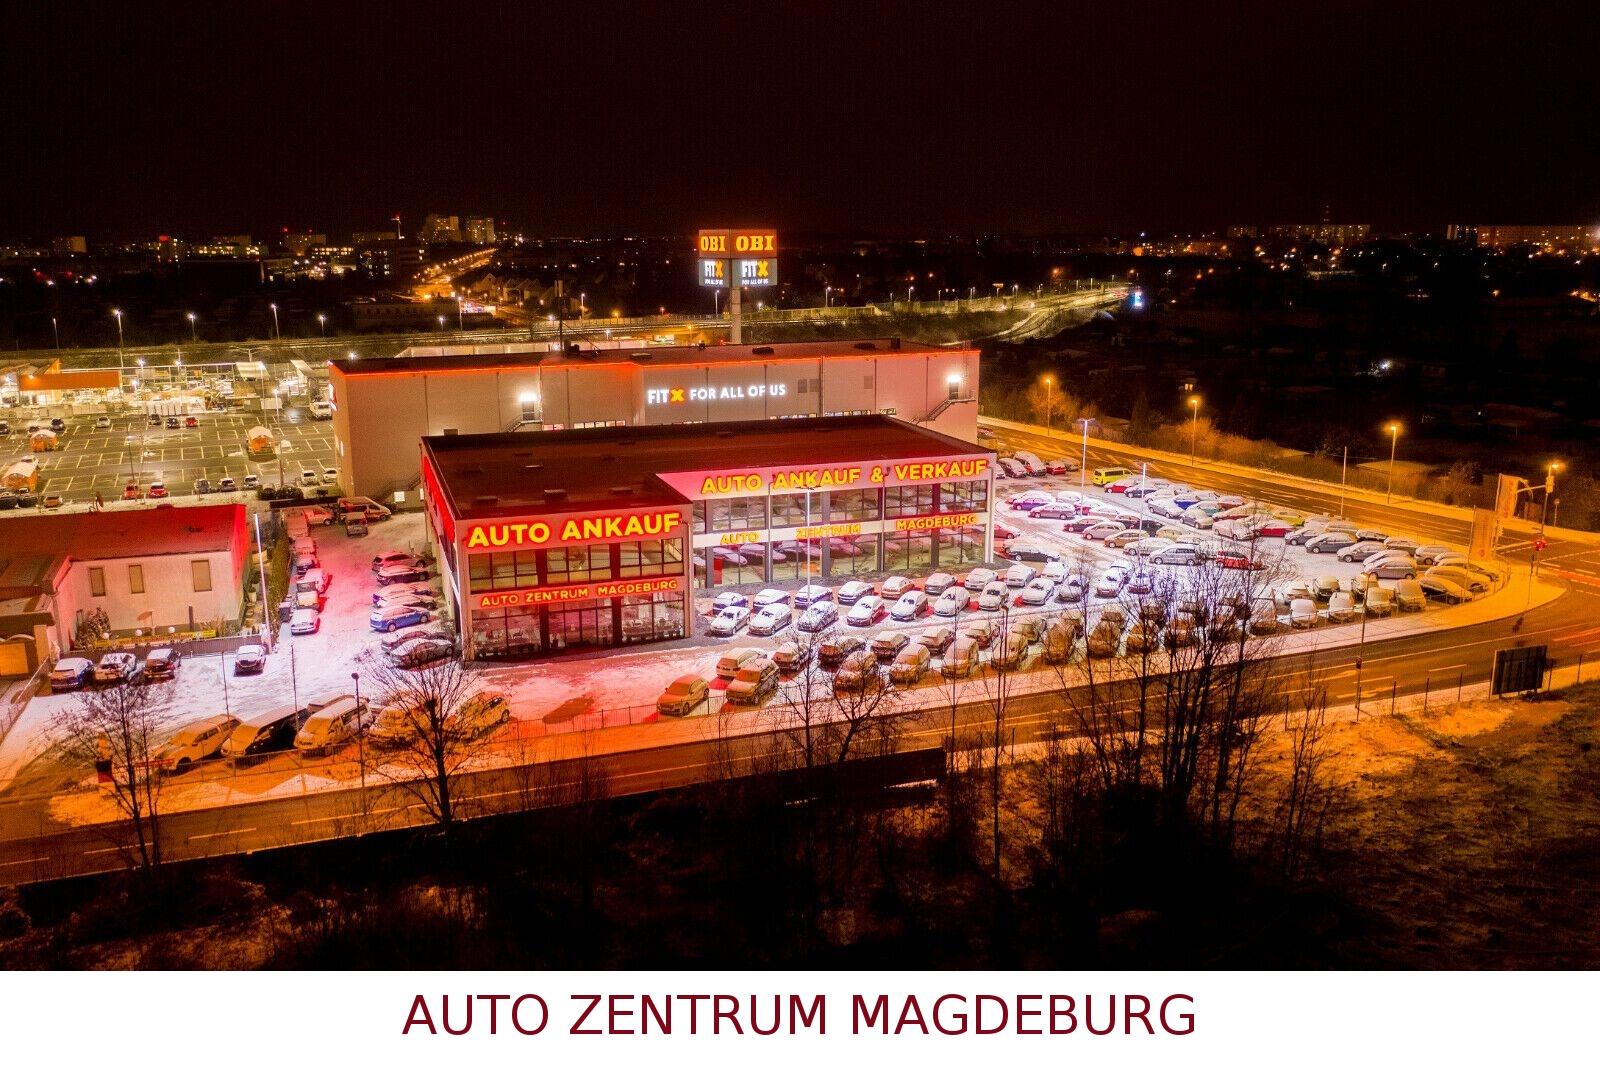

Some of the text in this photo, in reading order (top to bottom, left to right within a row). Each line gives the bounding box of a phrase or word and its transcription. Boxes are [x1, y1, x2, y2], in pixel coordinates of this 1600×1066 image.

[700, 235, 726, 252] OBI
[735, 235, 774, 252] OBI
[742, 260, 769, 278] FITX
[689, 388, 716, 401] FOR
[720, 386, 744, 399] ALL
[748, 385, 766, 397] OF
[769, 384, 786, 396] US
[701, 459, 988, 495] AUTO ANKAUF & VERKAUF
[467, 512, 680, 548] AUTO ANKAUF
[720, 531, 761, 546] AUTO
[896, 514, 978, 531] MAGDEBURG
[481, 579, 679, 607] AUTO ZENTRUM MAGDEBURG
